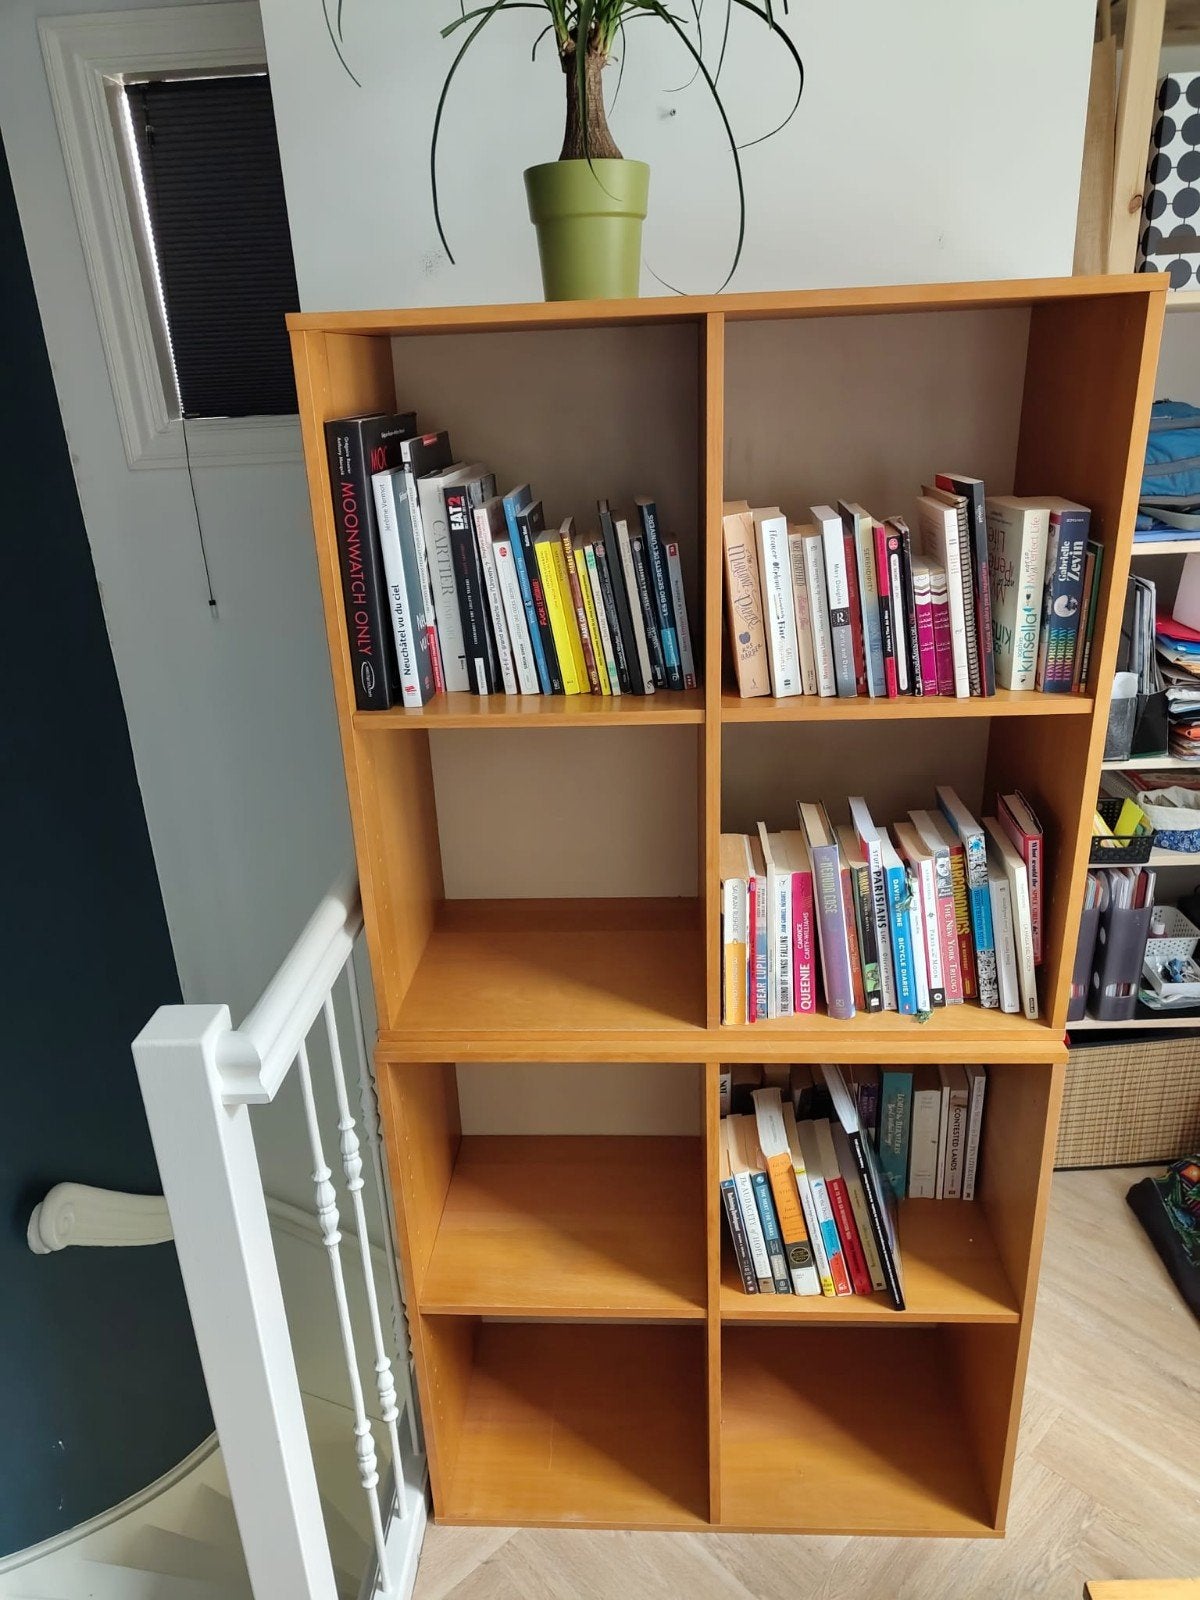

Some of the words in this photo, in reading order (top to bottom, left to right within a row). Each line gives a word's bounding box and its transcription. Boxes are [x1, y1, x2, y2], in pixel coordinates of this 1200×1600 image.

[379, 484, 387, 507] Vermot
[382, 509, 391, 532] Jérôme
[648, 515, 658, 550] L'UNIVERS
[1031, 517, 1040, 534] Life
[433, 520, 454, 596] CARTIER
[563, 537, 571, 554] CURIE
[654, 551, 660, 559] DE
[1028, 537, 1039, 566] Perfect
[341, 482, 366, 604] MOONWATCH
[354, 611, 371, 656] ONLY
[567, 555, 576, 574] PIERRE
[728, 544, 752, 590] MARLOWE
[864, 548, 874, 593] SERENDIPITY
[1058, 541, 1071, 582] Gabrielle
[1066, 540, 1085, 581] Zevin
[486, 567, 496, 592] l'Univers
[655, 560, 664, 590] SECRETS
[391, 585, 401, 601] ciel
[394, 603, 402, 615] du
[538, 607, 547, 626] FUCK
[735, 594, 760, 630] PAPERS
[398, 617, 404, 628] vu
[778, 621, 787, 639] Fine
[499, 634, 507, 650] grand
[839, 629, 847, 646] Purity
[1018, 613, 1037, 673] kinsella
[398, 630, 411, 676] Neuchâtel
[1046, 628, 1059, 681] TOMORROW
[1054, 628, 1067, 681] TOMORROW
[1063, 628, 1076, 681] TOMORROW
[842, 660, 850, 680] Danger
[820, 862, 837, 893] NERUDA
[893, 879, 901, 901] DAVID
[823, 894, 838, 915] CASE
[873, 871, 887, 928] PARISIANS
[950, 855, 970, 935] NARCONOMICS
[944, 902, 953, 919] THE
[946, 920, 954, 939] NEW
[898, 938, 907, 966] BICYCLE
[948, 940, 957, 961] YORK
[757, 954, 766, 979] LUPIN
[949, 964, 959, 994] TRILOGY
[757, 983, 766, 1004] DEAR
[781, 987, 789, 1002] SOUND
[800, 964, 811, 1009] QUEENIE
[901, 969, 909, 996] DIARIES
[781, 1003, 789, 1012] THE
[952, 1108, 961, 1147] CONTESTED
[739, 1177, 747, 1188] The
[742, 1188, 756, 1226] AUDACITY
[767, 1222, 775, 1236] YEARS
[752, 1236, 763, 1258] HOPE
